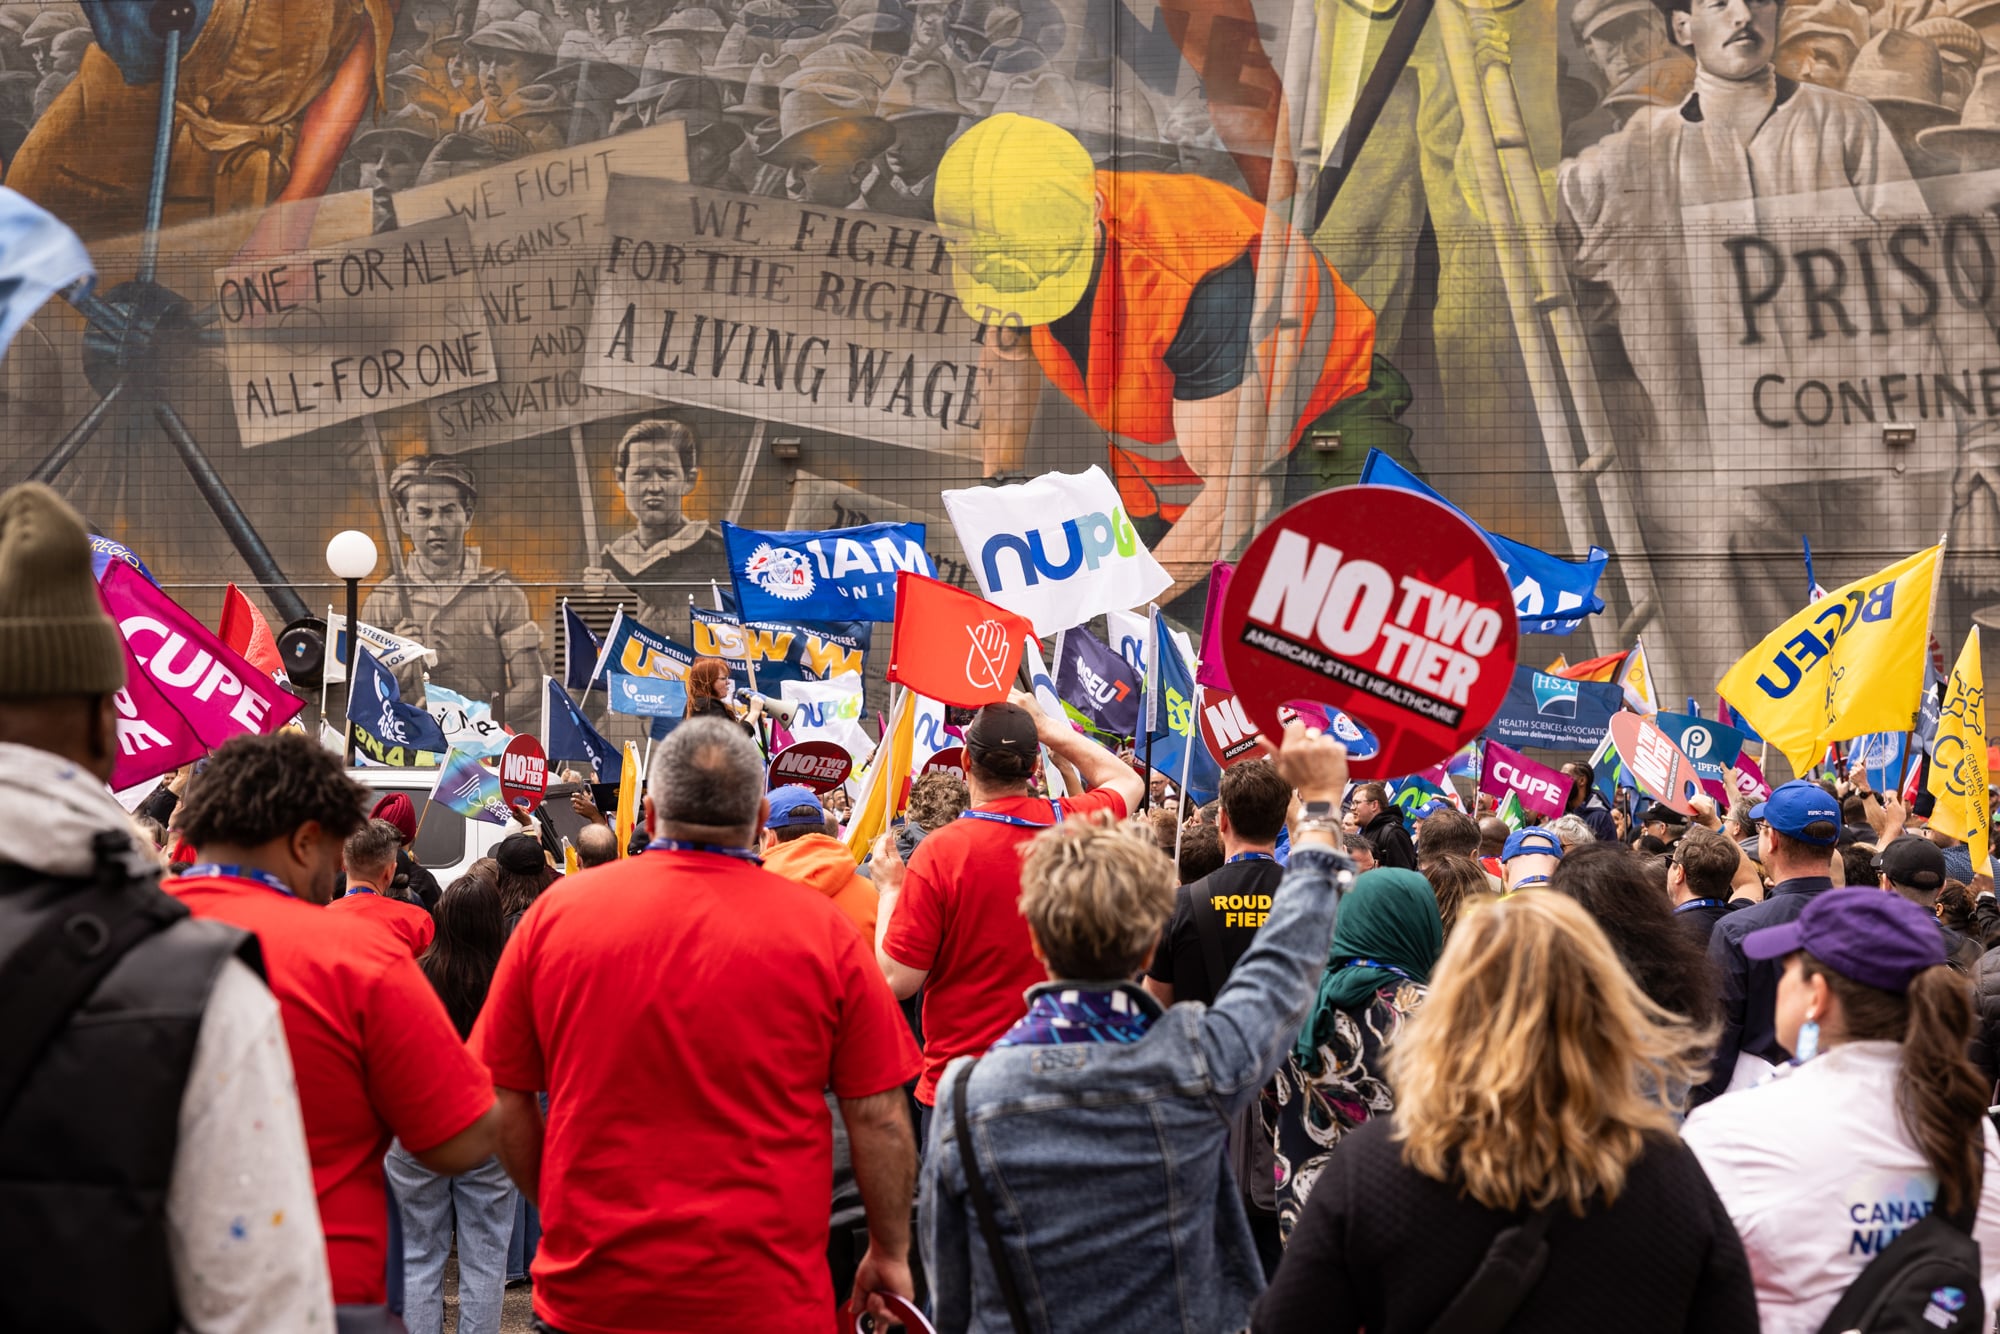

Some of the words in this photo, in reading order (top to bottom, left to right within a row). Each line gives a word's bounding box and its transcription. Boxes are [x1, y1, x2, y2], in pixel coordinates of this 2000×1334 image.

[445, 181, 506, 222] WE
[516, 149, 616, 206] FIGHT
[481, 213, 588, 272] AGAINST
[690, 196, 761, 245] WE
[796, 209, 957, 276] FIGHT
[220, 265, 298, 324] ONE
[312, 247, 393, 298] FOR
[402, 236, 469, 291] ALL
[605, 235, 688, 286] FOR
[695, 248, 795, 304] THE
[812, 269, 963, 336] RIGHT
[1721, 215, 2000, 346] PRISO
[416, 331, 489, 387] ONE
[530, 325, 585, 362] AND
[603, 301, 637, 364] A
[649, 308, 831, 403] LIVING
[845, 341, 993, 432] WAGE
[93, 537, 142, 574] REGIO
[806, 537, 930, 578] IAM
[1247, 527, 1395, 657] NO
[1397, 575, 1503, 658] TWO
[362, 626, 401, 651] STEELWO
[634, 629, 663, 649] UNITED
[692, 620, 796, 661] USW
[119, 615, 272, 735] CUPE
[1244, 629, 1366, 689] AMERICAN-STYLE
[1365, 675, 1460, 725] HEALTHCARE
[1374, 622, 1481, 706] TIER
[1537, 673, 1576, 693] HSA
[634, 694, 665, 704] CURC
[1499, 718, 1529, 728] HEALTH
[1531, 719, 1562, 733] SCIENCES
[1562, 724, 1609, 736] ASSOCIATIO
[1499, 727, 1510, 736] The
[1511, 729, 1529, 737] union
[1579, 737, 1599, 745] health
[776, 752, 818, 774] NO
[819, 756, 848, 769] TWO
[1225, 735, 1259, 758] AMERICAN-
[503, 752, 527, 783] NO
[526, 755, 545, 772] TWO
[525, 769, 543, 786] TIER
[813, 766, 842, 779] TIER
[1493, 761, 1562, 805] CUPE
[1965, 753, 1985, 793] GENERAL
[486, 795, 513, 817] OPSE
[1210, 894, 1272, 910] ROUD
[1849, 1229, 1902, 1255] NU
